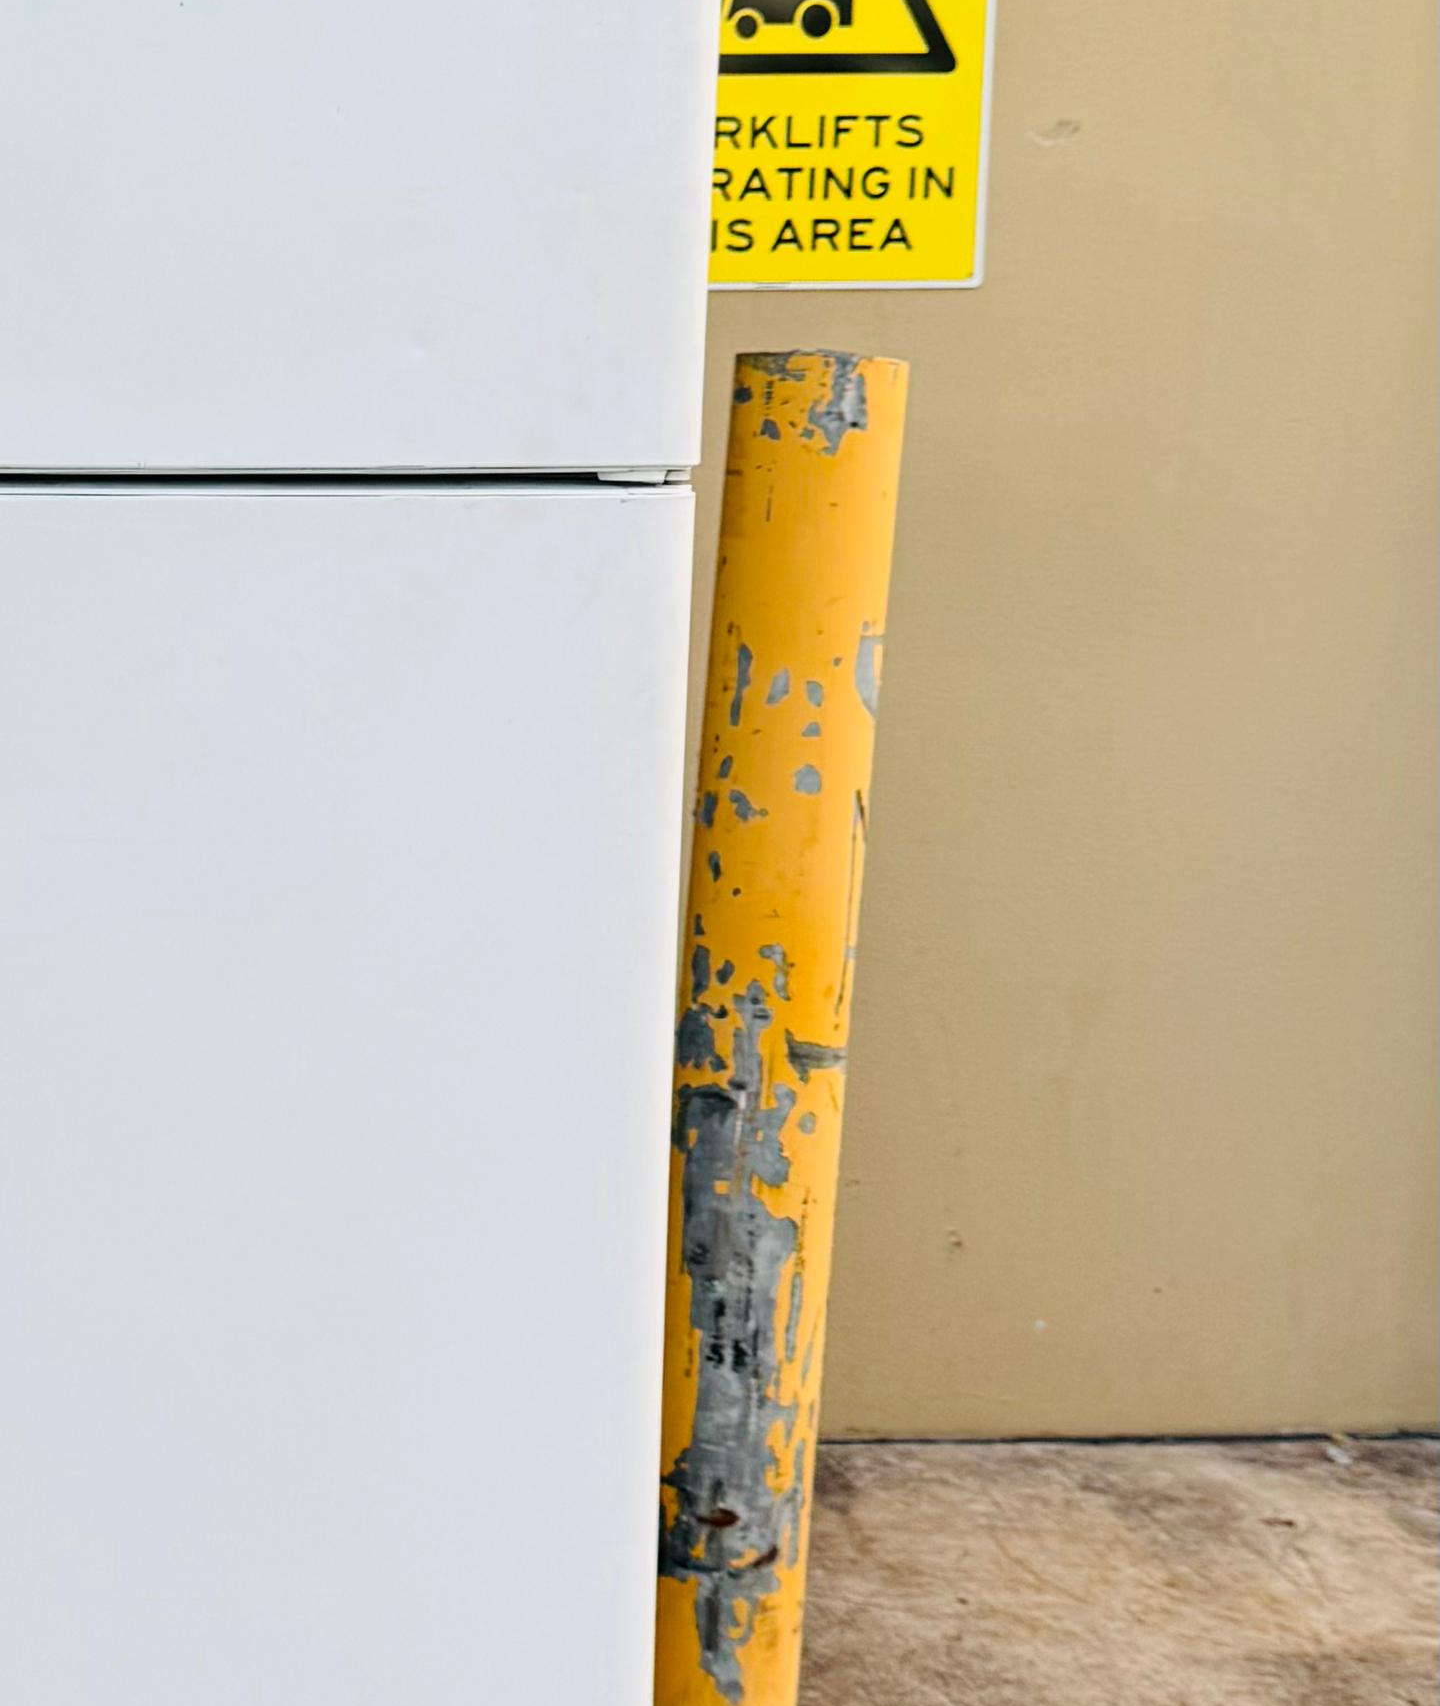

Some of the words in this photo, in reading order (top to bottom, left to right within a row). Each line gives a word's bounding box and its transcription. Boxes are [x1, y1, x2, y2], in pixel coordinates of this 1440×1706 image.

[714, 115, 924, 149] RKLIFTS
[712, 166, 891, 201] RATING
[909, 166, 954, 199] IN
[711, 218, 754, 252] IS
[771, 218, 913, 252] AREA
